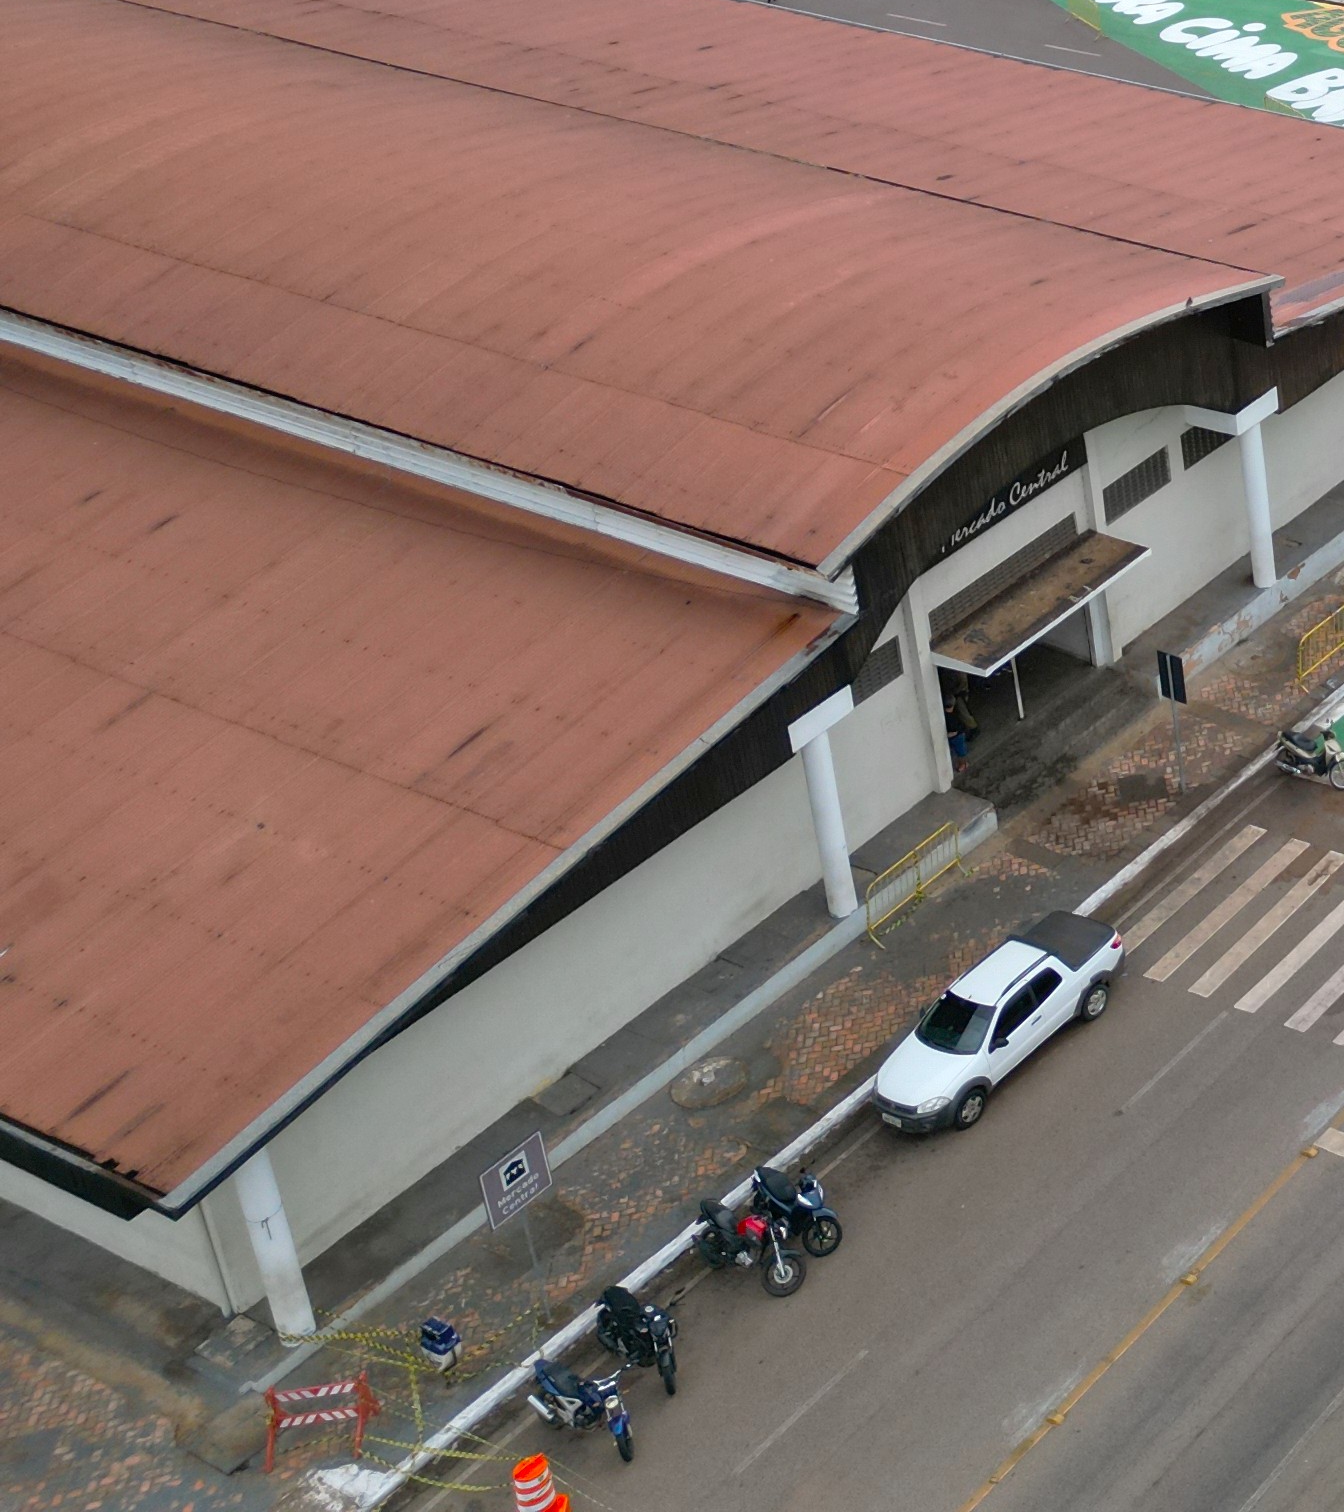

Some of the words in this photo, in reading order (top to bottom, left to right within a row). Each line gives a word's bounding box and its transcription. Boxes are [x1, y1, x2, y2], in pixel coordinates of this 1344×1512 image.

[1009, 450, 1069, 506] Central
[498, 1172, 540, 1208] Mercado
[502, 1182, 539, 1215] Central
